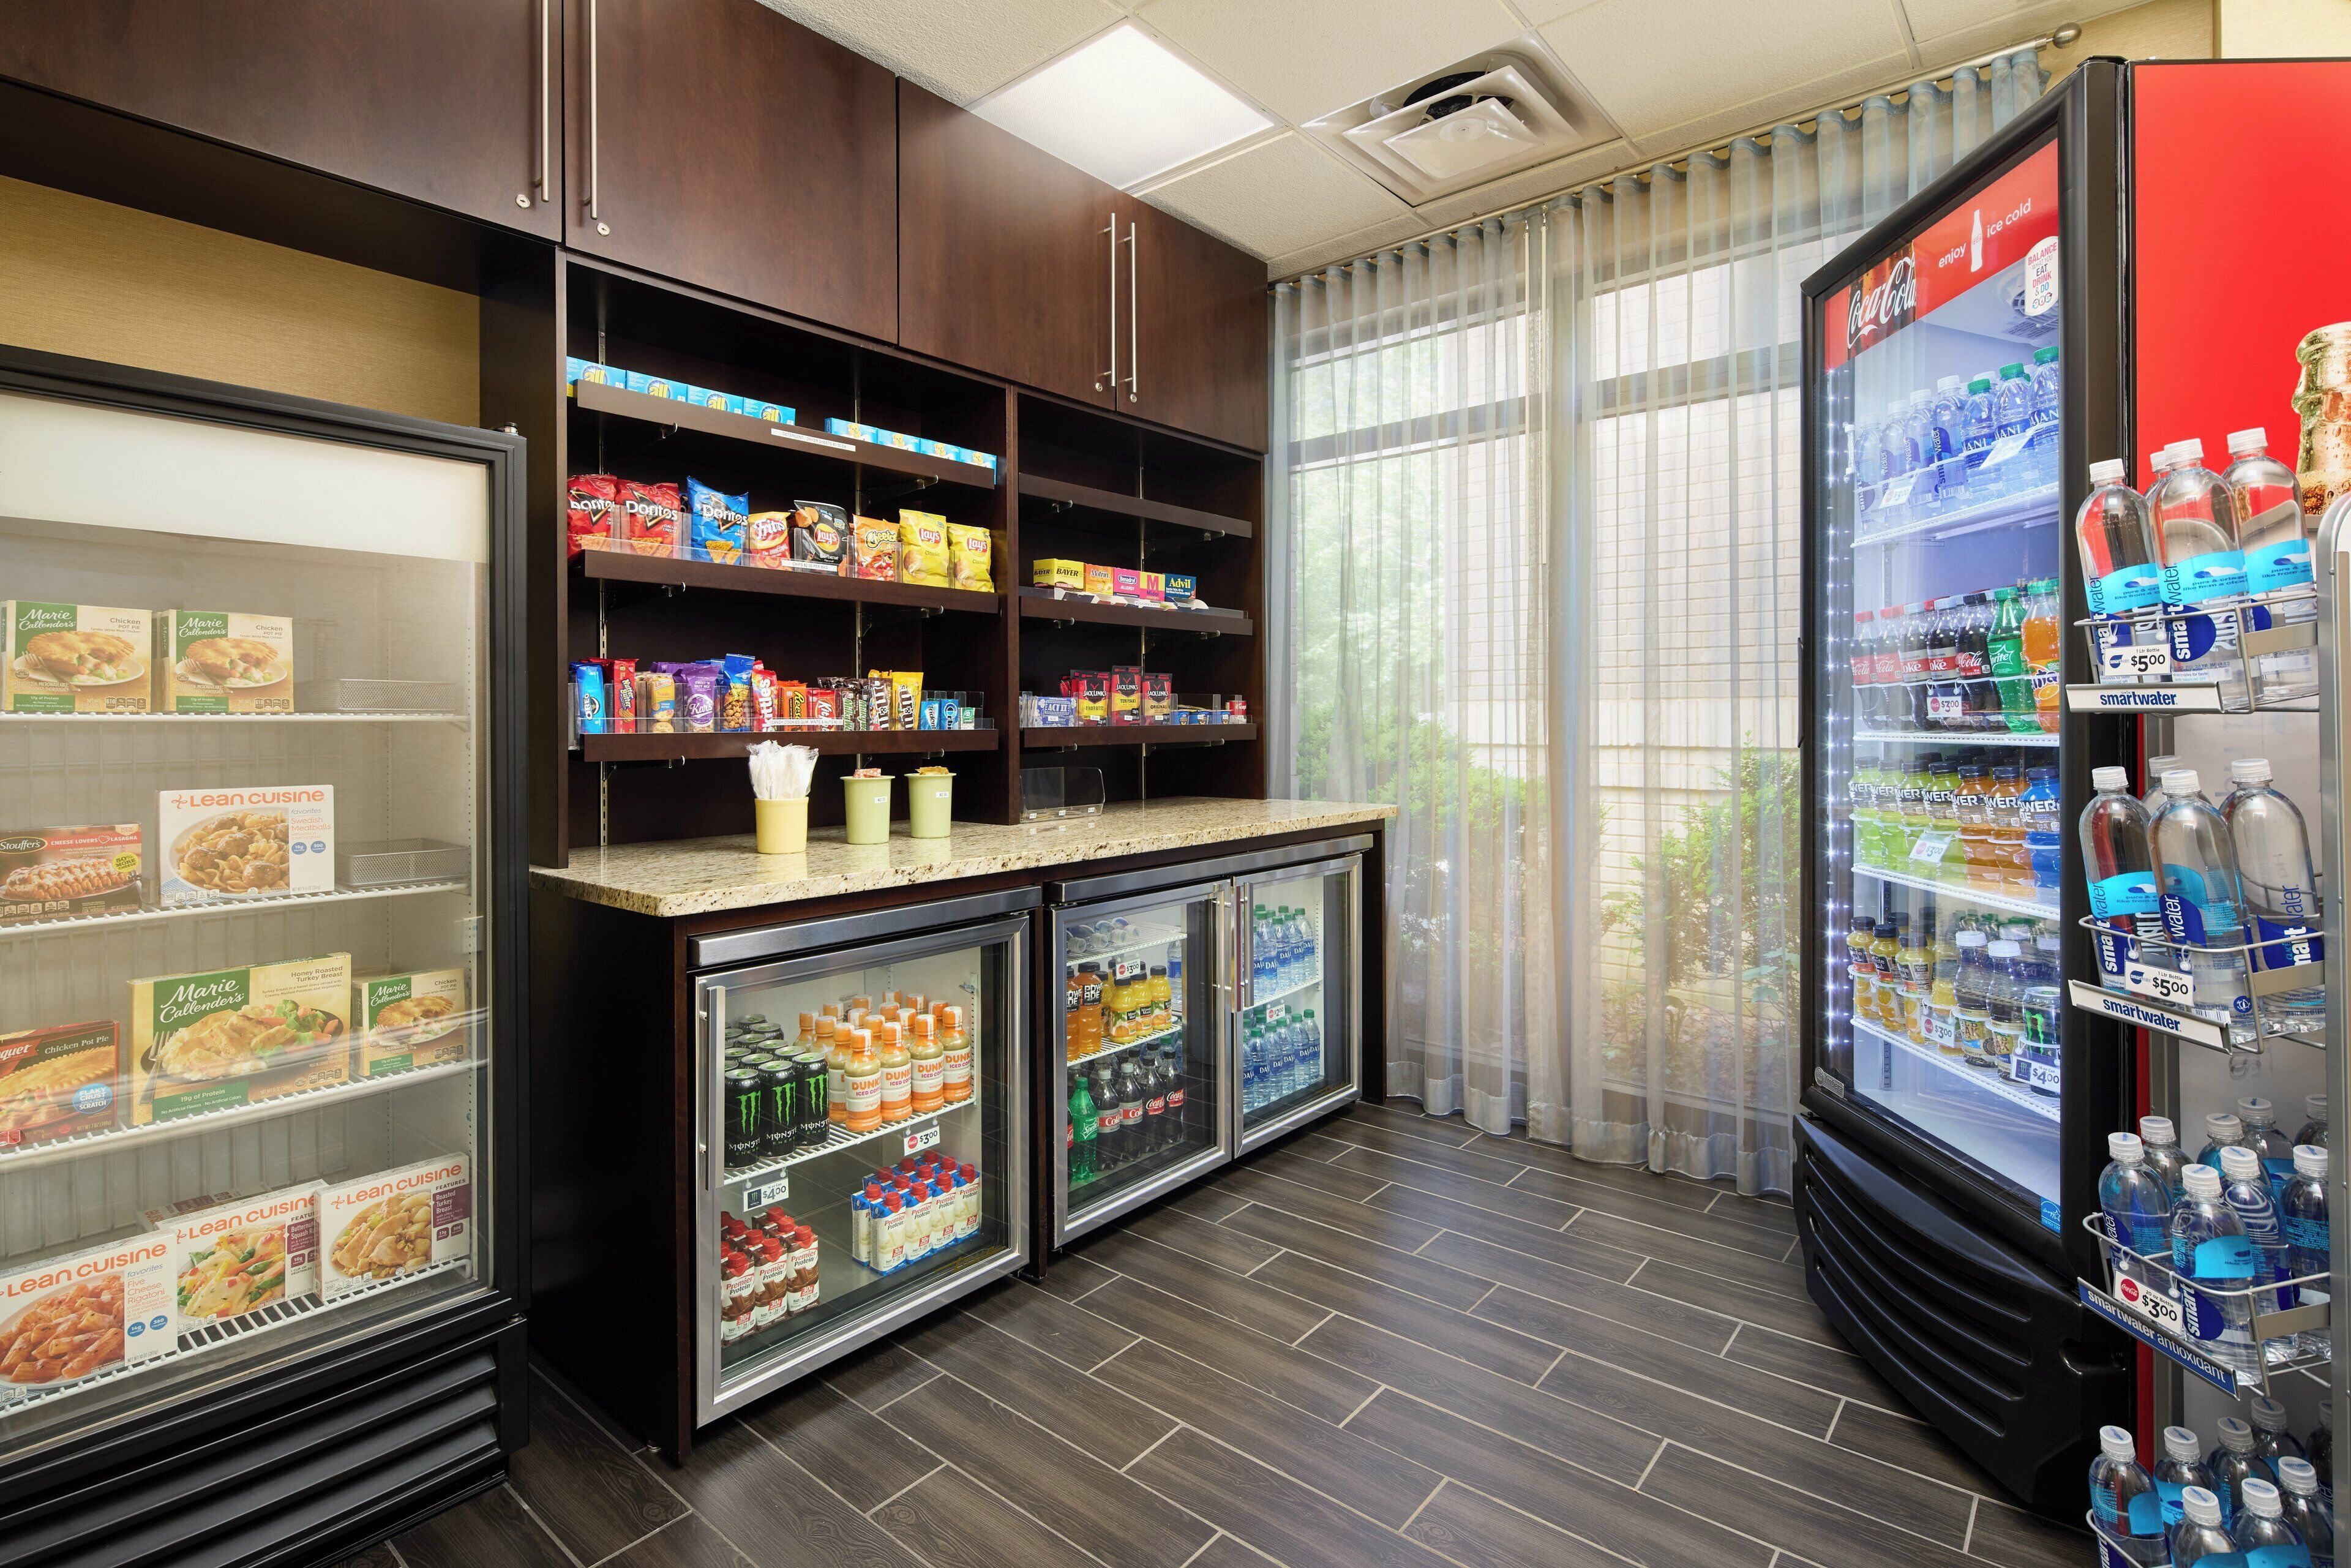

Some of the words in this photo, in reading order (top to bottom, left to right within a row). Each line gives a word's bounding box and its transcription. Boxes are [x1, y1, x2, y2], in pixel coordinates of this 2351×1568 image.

[1987, 219, 2003, 238] ice
[2005, 197, 2032, 226] cold
[1938, 241, 1967, 268] enjoy
[2027, 241, 2058, 266] BALANCE
[2036, 263, 2048, 277] EAT
[2032, 270, 2052, 289] DRINK
[2040, 281, 2050, 294] DO
[1847, 252, 1917, 350] Coca-Cola
[626, 500, 678, 521] Doritos
[702, 504, 748, 525] Doritos
[817, 529, 838, 546] Lay's
[920, 528, 941, 544] Lay's
[968, 537, 988, 552] Lay's
[1056, 568, 1079, 577] BAYER
[1119, 576, 1136, 584] Benadryl
[1169, 577, 1192, 589] Advil
[19, 609, 73, 621] Marie
[18, 620, 76, 631] Callender's
[179, 617, 223, 629] Marie
[178, 628, 227, 637] Callender's
[2099, 691, 2177, 705] smartwater
[0, 839, 41, 851] Stouffer's
[115, 858, 136, 867] MORE
[291, 969, 314, 978] Honey
[315, 966, 343, 975] Roasted
[296, 975, 320, 983] Turkey
[160, 979, 239, 1009] Marie
[370, 983, 408, 999] Marie
[1084, 991, 1100, 1000] ADE
[370, 990, 411, 1007] Callender's
[160, 992, 245, 1024] Callender's
[2102, 998, 2181, 1032] smartwater
[44, 1041, 79, 1054] Chicken
[96, 1035, 109, 1044] Pie
[79, 1086, 107, 1097] FLAKY
[79, 1092, 106, 1101] CRUST
[201, 1089, 225, 1098] Protein
[79, 1100, 107, 1110] SCRATCH
[435, 1178, 466, 1191] FEATURES
[959, 1185, 979, 1196] Premier
[436, 1190, 456, 1201] Roasted
[936, 1194, 956, 1206] Premier
[962, 1191, 977, 1199] Protein
[436, 1198, 453, 1208] Turkey
[939, 1201, 954, 1209] Protein
[436, 1205, 452, 1214] Breast
[912, 1204, 931, 1216] Premier
[914, 1210, 930, 1220] Protein
[885, 1214, 905, 1226] Premier
[887, 1221, 904, 1231] Protein
[791, 1250, 817, 1262] Premier
[794, 1257, 814, 1267] Protein
[127, 1263, 163, 1278] favorites
[759, 1262, 786, 1276] Premier
[762, 1270, 783, 1281] Protein
[127, 1277, 146, 1288] Five
[127, 1281, 162, 1296] Cheese
[726, 1276, 752, 1290] Premier
[729, 1283, 751, 1295] Protein
[127, 1288, 165, 1305] Rigatoni
[2159, 1296, 2174, 1308] Bottle
[2087, 1289, 2156, 1341] smartwater
[2157, 1331, 2227, 1384] antioxidant
